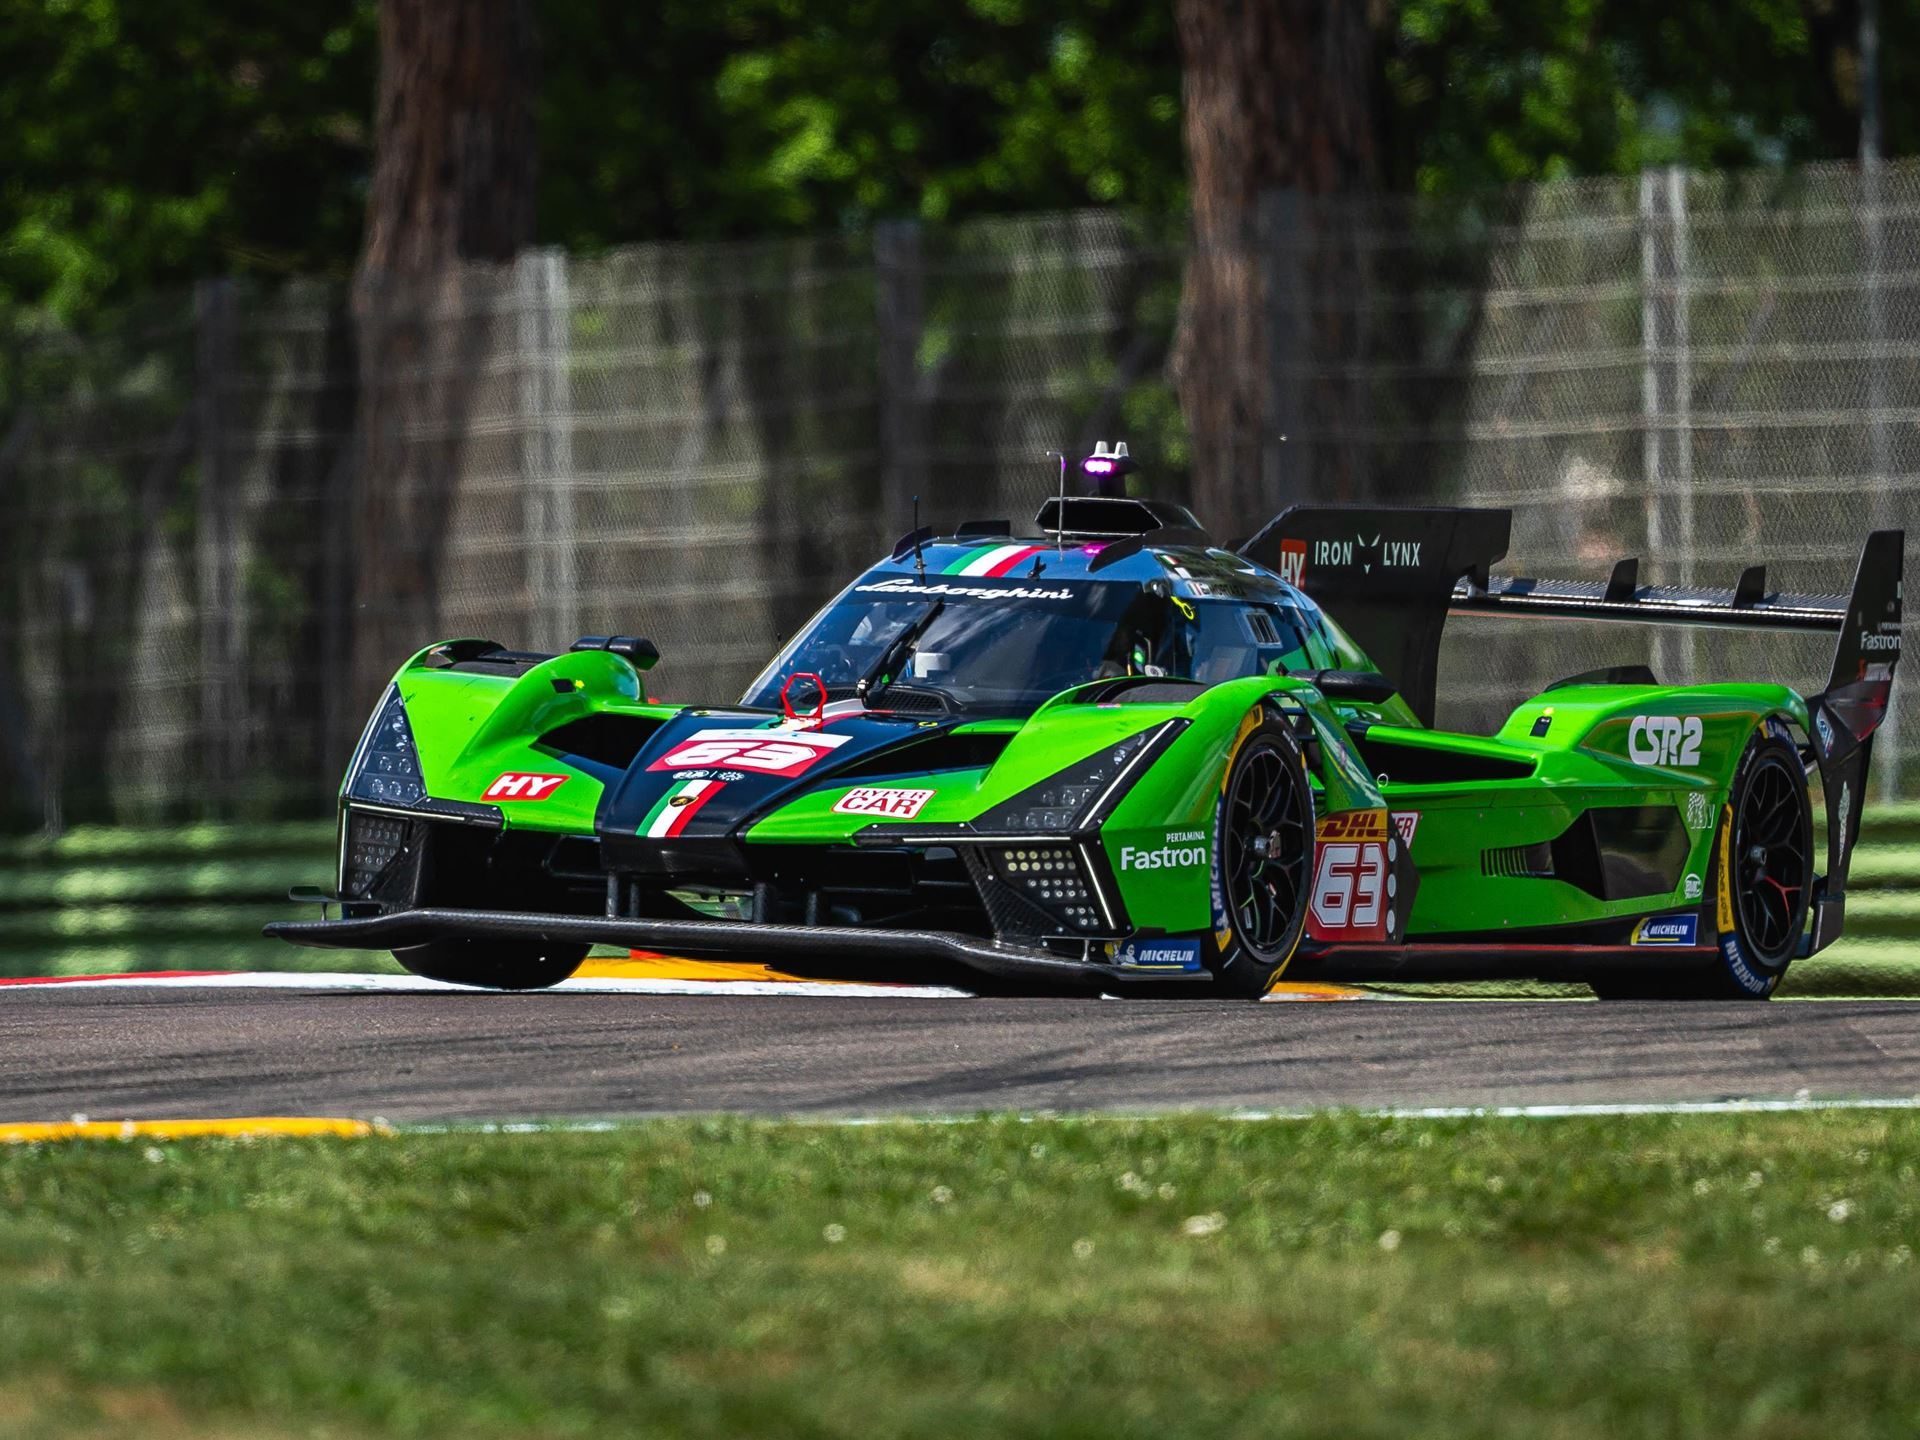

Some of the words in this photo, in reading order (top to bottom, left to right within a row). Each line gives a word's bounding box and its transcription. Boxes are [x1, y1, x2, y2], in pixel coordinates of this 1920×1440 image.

[1314, 541, 1353, 566] IRON
[1383, 542, 1421, 567] LYNX
[1280, 551, 1305, 588] HY
[855, 578, 1074, 600] Lamborghini
[1860, 630, 1901, 650] Fastron
[1628, 715, 1703, 766] CSR2
[664, 742, 817, 770] 63
[487, 775, 563, 796] HY
[853, 789, 927, 799] HYPER
[842, 796, 918, 815] CAR
[1321, 813, 1379, 837] DHL
[1165, 831, 1206, 843] PERTAMINA
[1120, 846, 1207, 871] Fastron
[1310, 843, 1384, 927] 63
[1649, 924, 1689, 936] MICHELIN
[1140, 949, 1195, 962] MICHELIN
[1725, 940, 1766, 993] MICHELIN
